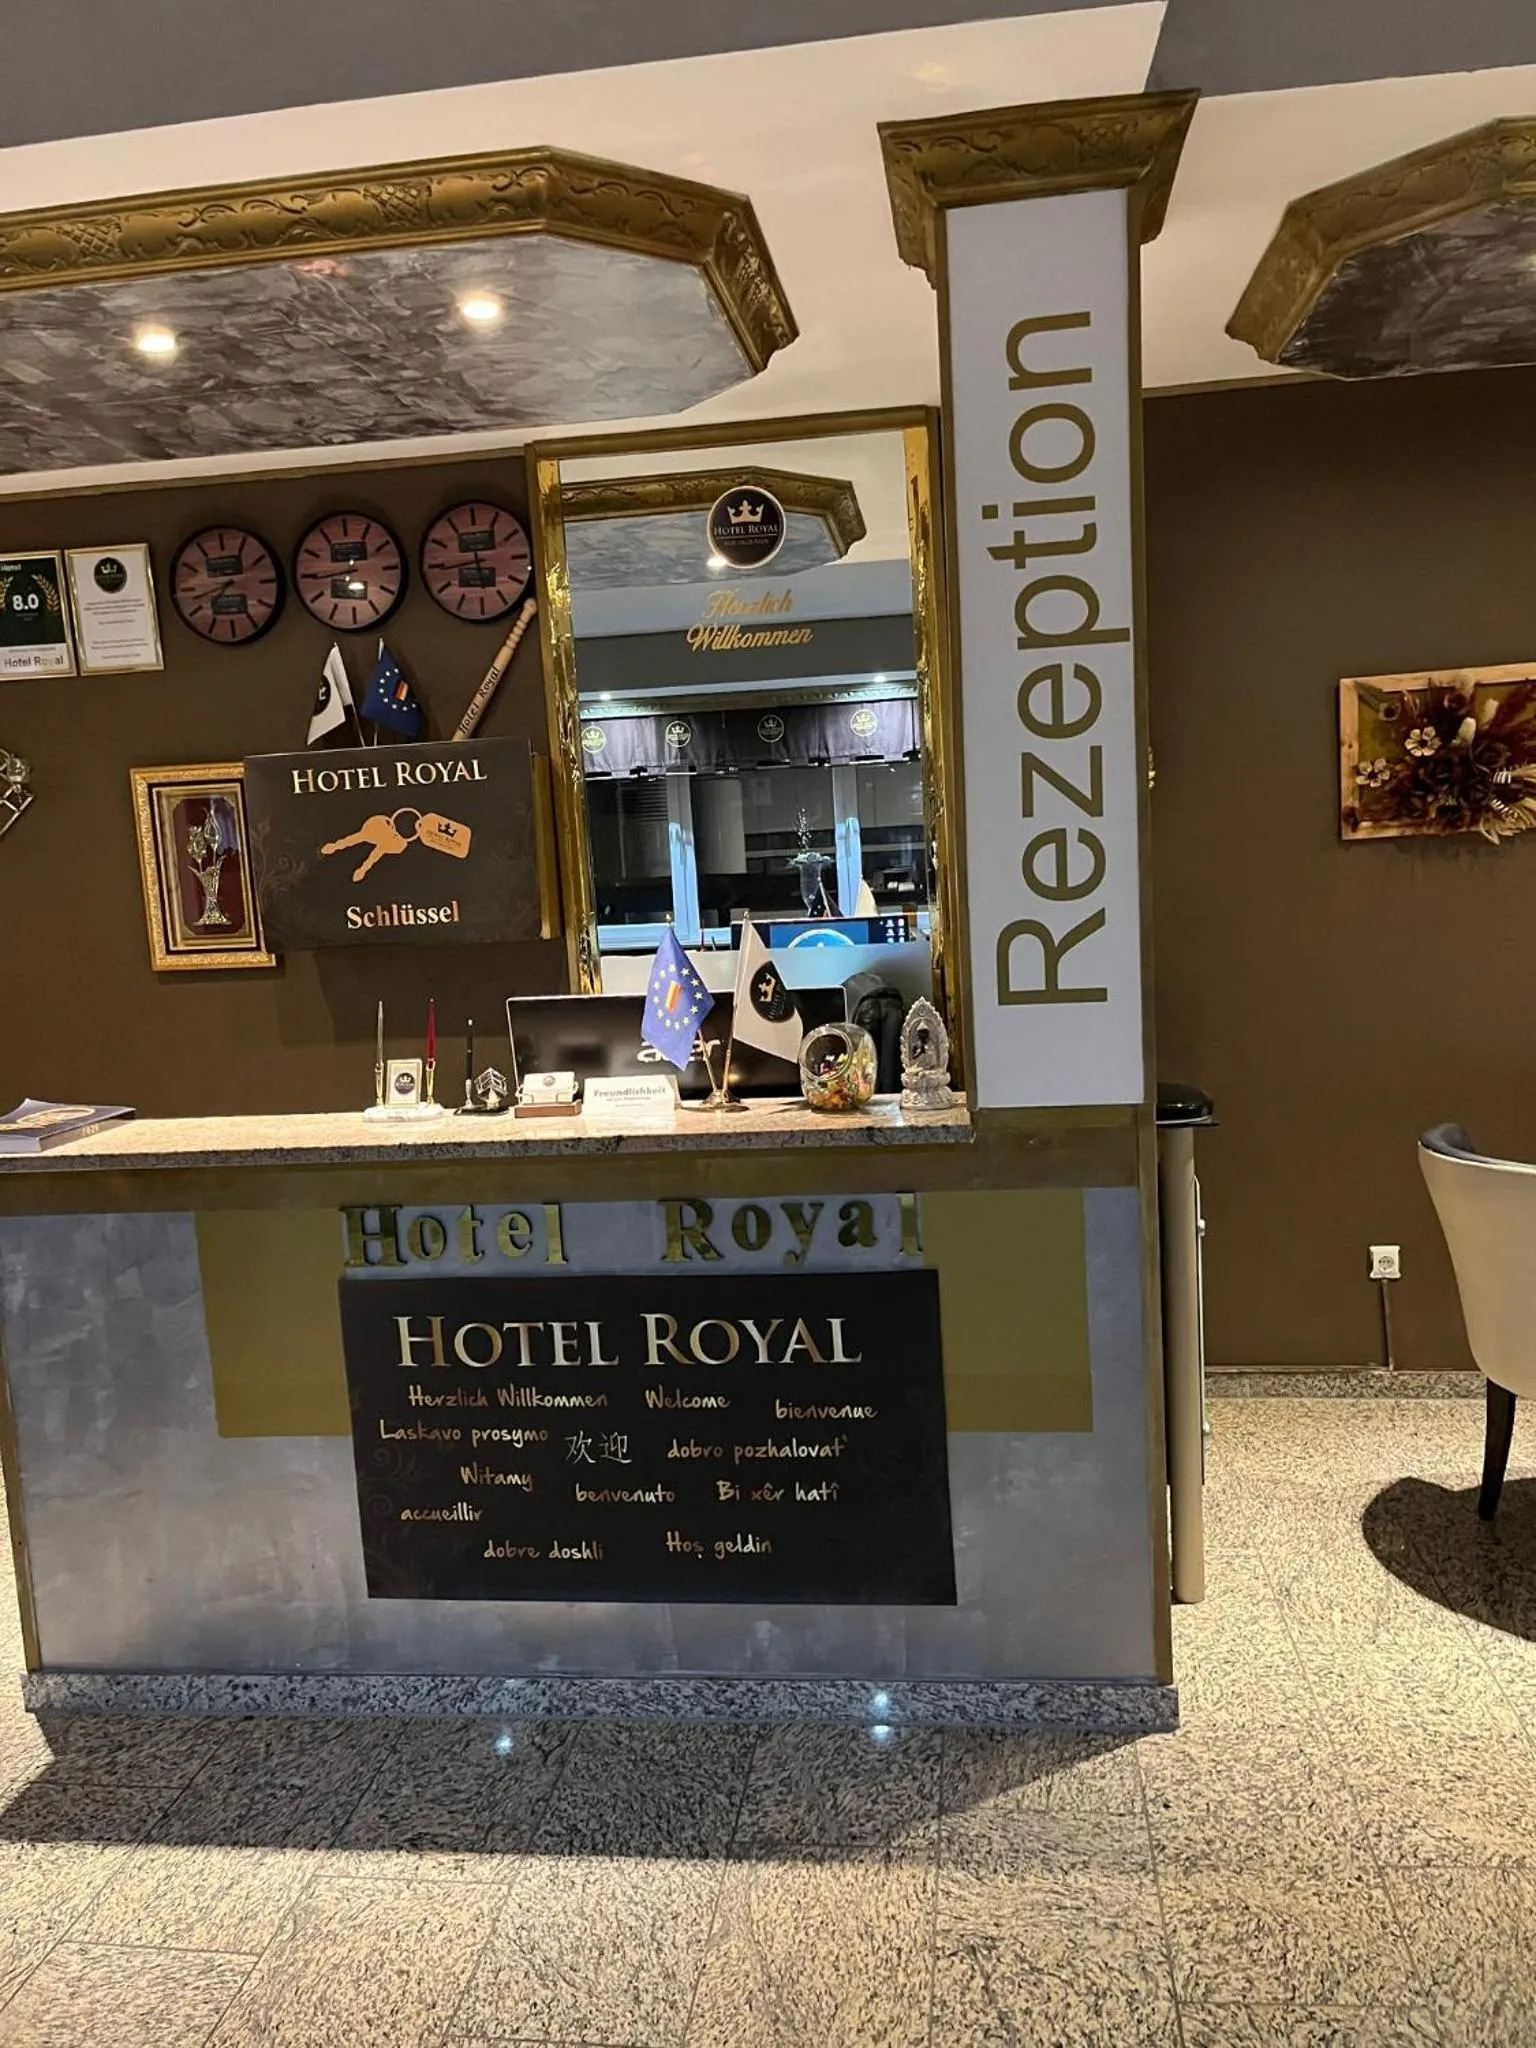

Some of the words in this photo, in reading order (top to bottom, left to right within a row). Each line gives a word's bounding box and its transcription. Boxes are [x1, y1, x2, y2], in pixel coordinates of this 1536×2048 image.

[713, 525, 746, 537] HOTEL
[748, 523, 778, 535] ROYAL
[12, 593, 39, 611] 8.0
[686, 622, 814, 653] Willkommen
[4, 657, 31, 669] Hotel
[981, 310, 1131, 1007] Rezeption
[458, 702, 480, 735] Hotel
[479, 665, 501, 699] Royal
[291, 766, 388, 794] HOTEL
[395, 758, 488, 787] ROYAL
[346, 900, 460, 929] Schlüssel
[637, 1039, 721, 1062] aer
[339, 1203, 570, 1268] Hotel
[656, 1191, 925, 1268] Royal
[392, 1315, 620, 1368] HOTEL
[639, 1312, 862, 1366] ROYAL
[408, 1384, 489, 1408] Herzlich
[496, 1383, 609, 1408] Willkommen
[645, 1384, 731, 1410] Welcome
[774, 1398, 879, 1420] bienvenue
[379, 1418, 462, 1441] Laskavo
[471, 1429, 549, 1449] prosymo
[563, 1429, 633, 1465] 欢迎
[666, 1438, 724, 1460] dobro
[459, 1461, 535, 1493] Witamy
[575, 1483, 676, 1503] benvenuto
[716, 1479, 741, 1502] Bi
[750, 1483, 786, 1502] xêr
[400, 1501, 486, 1522] accueillir
[483, 1539, 542, 1560] dobre
[548, 1540, 604, 1561] doshli
[714, 1532, 773, 1560] geldin
